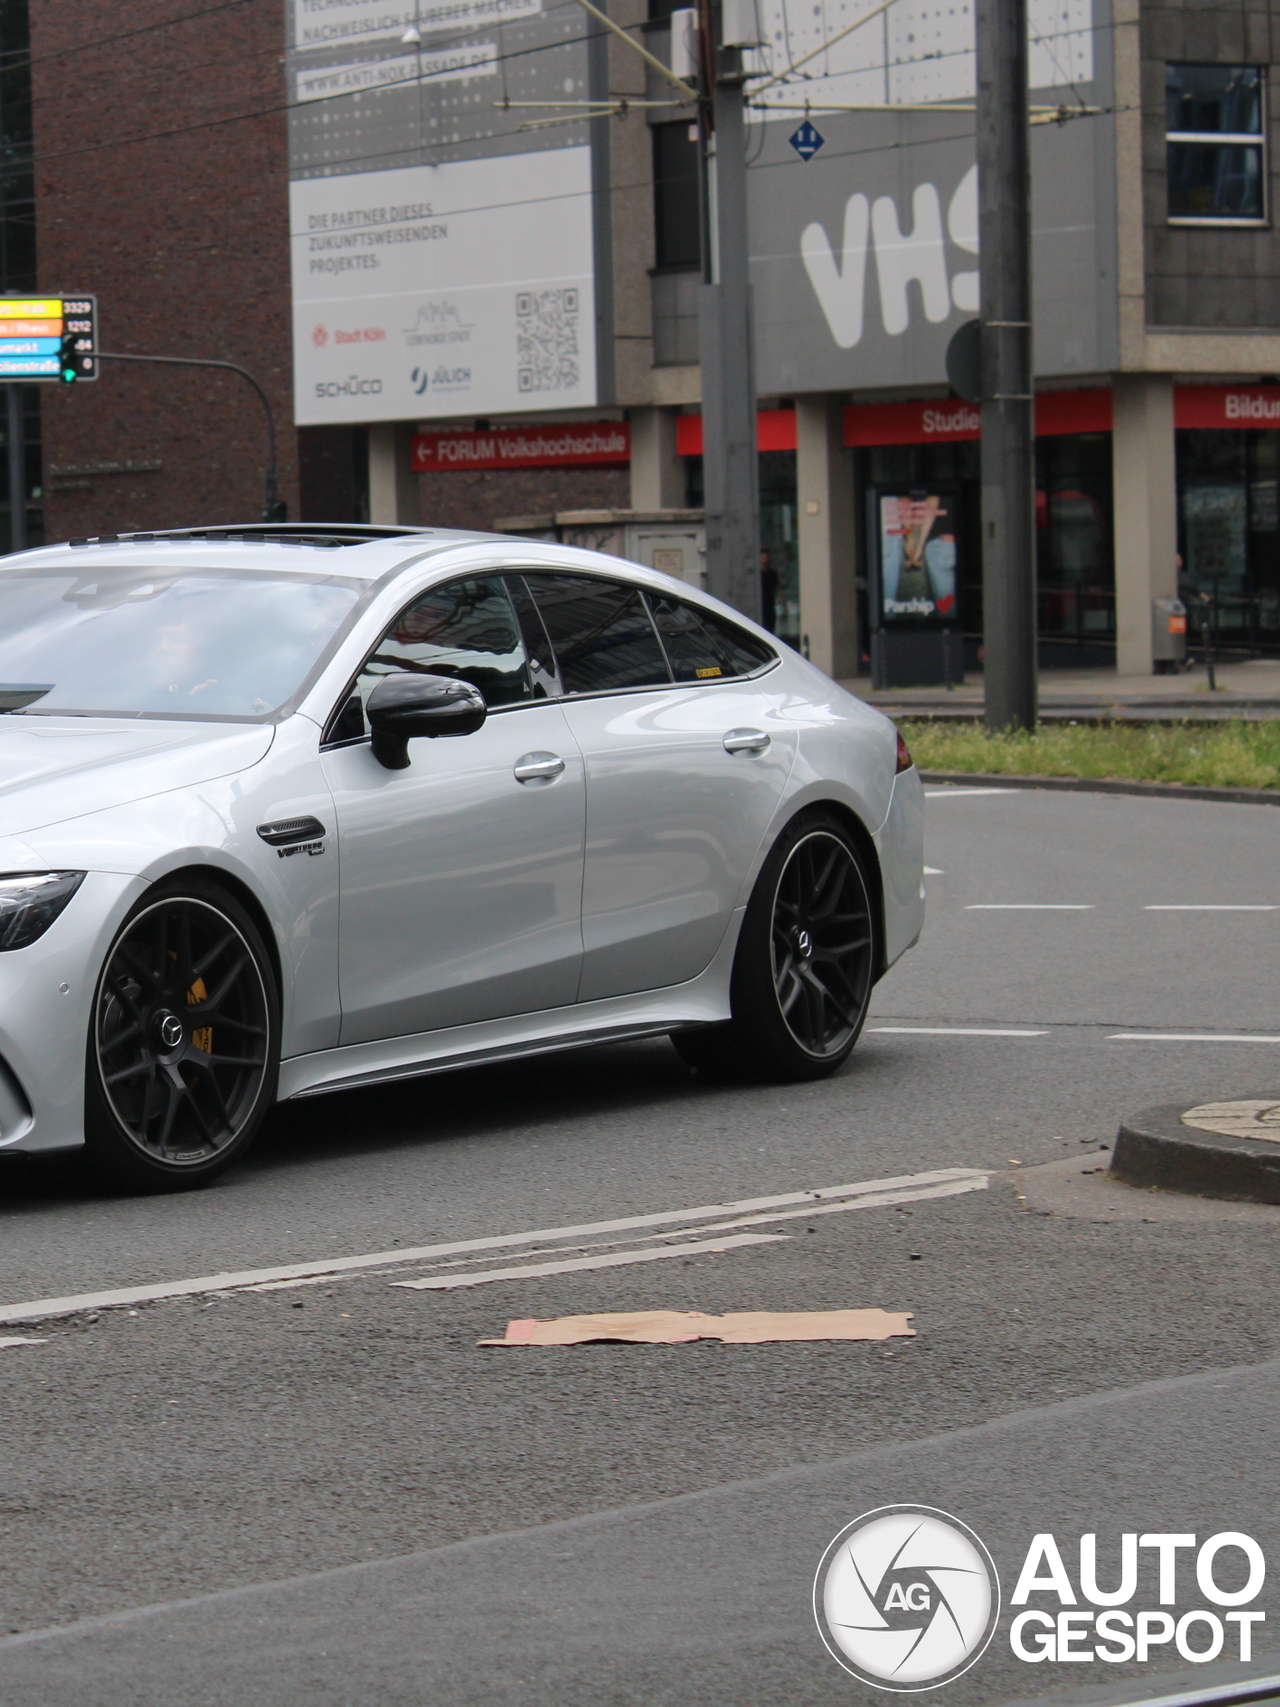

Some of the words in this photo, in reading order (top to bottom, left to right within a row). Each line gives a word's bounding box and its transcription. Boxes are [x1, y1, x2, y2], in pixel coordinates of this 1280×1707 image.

[308, 214, 329, 230] DIE
[331, 206, 388, 228] PARTNER
[390, 201, 433, 223] DIESES
[308, 223, 449, 252] ZUKUNFTSWEISENDEN
[309, 254, 381, 276] PROJEKTES:
[316, 375, 382, 399] SCHÜCO
[437, 438, 496, 462] FORUM
[498, 430, 625, 459] Volkshochschule
[883, 597, 935, 616] Parship
